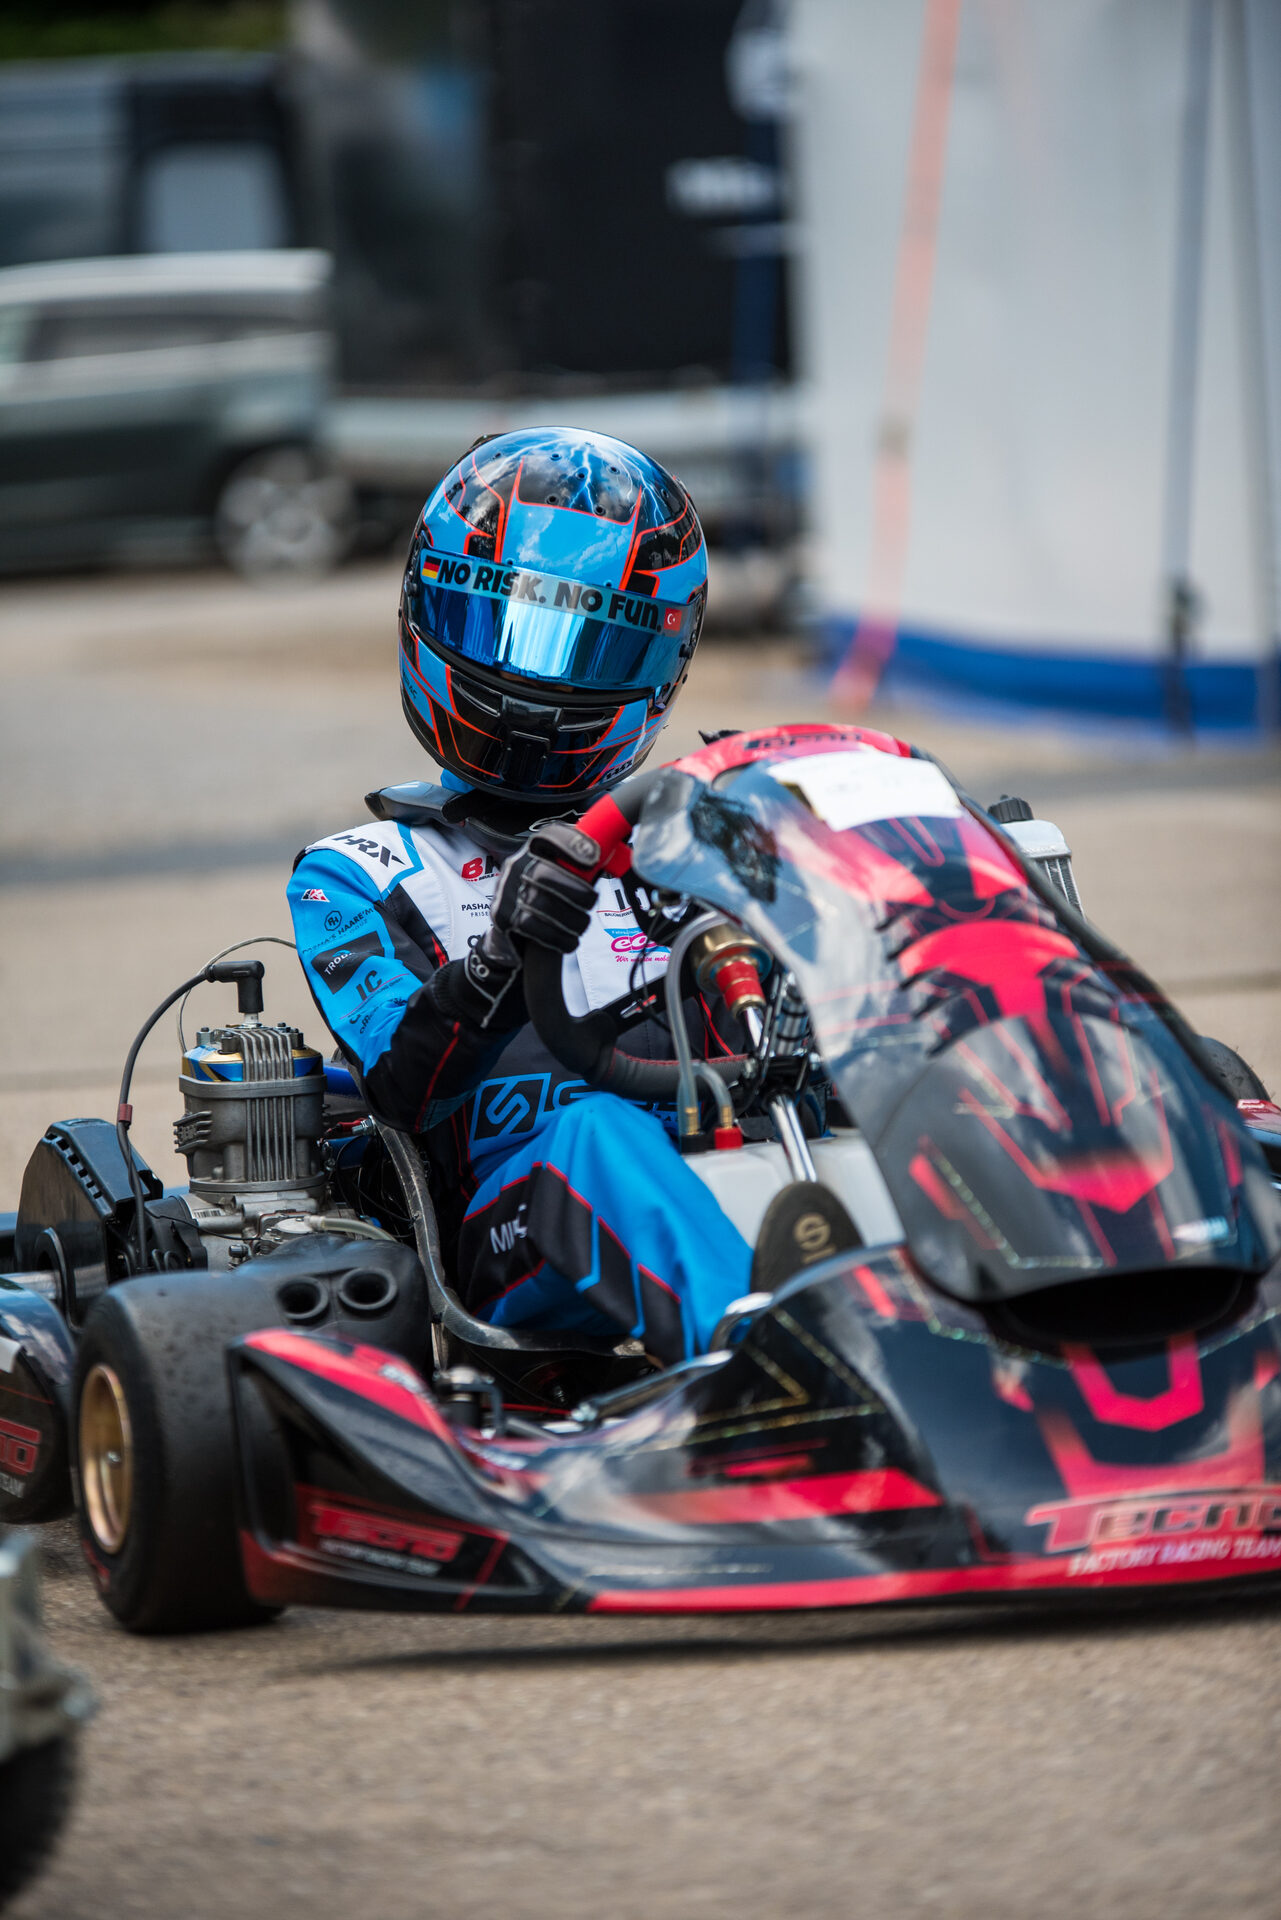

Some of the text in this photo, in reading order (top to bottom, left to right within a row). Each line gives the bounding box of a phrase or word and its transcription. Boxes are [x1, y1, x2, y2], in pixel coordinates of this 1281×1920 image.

[437, 558, 472, 585] NO
[472, 565, 547, 604] RISK.
[553, 581, 605, 613] NO
[461, 902, 493, 912] PASHA
[1157, 1540, 1232, 1564] RACING
